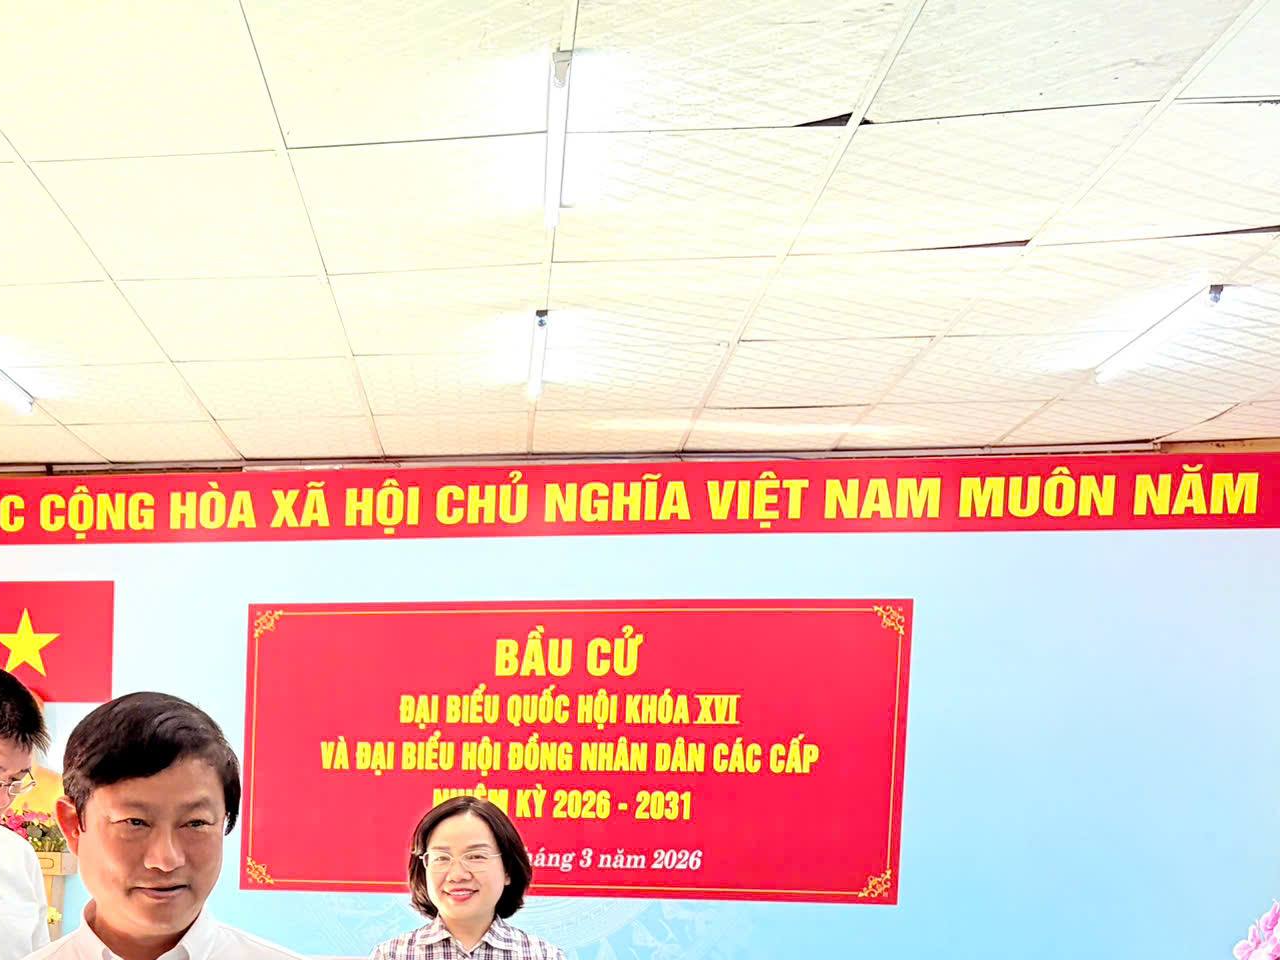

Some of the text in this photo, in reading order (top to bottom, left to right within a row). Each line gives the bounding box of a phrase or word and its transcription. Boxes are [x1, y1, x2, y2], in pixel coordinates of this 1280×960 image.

[39, 486, 155, 539] CỘNG
[169, 482, 257, 530] HÒA
[271, 481, 330, 529] XÃ
[344, 479, 420, 534] HỘI
[435, 471, 529, 525] CHỦ
[543, 473, 691, 523] NGHĨA
[706, 471, 810, 529] VIỆT
[823, 477, 941, 520] NAM
[958, 466, 1116, 518] MUÔN
[1133, 464, 1259, 516] NĂM
[495, 625, 644, 677] BẦU CỬ
[399, 683, 741, 730] ĐẠI BIỂU QUỐC HỘI KHÓA XVI
[320, 731, 820, 777] VÀ ĐẠI BIỂU HỘI ĐỒNG NHÂN DÂN CÁC CẤP
[516, 784, 547, 818] KỲ
[553, 790, 610, 819] 2026
[635, 791, 691, 820] 2031
[579, 848, 593, 868] 3
[598, 849, 646, 869] năm
[651, 849, 703, 870] 2026
